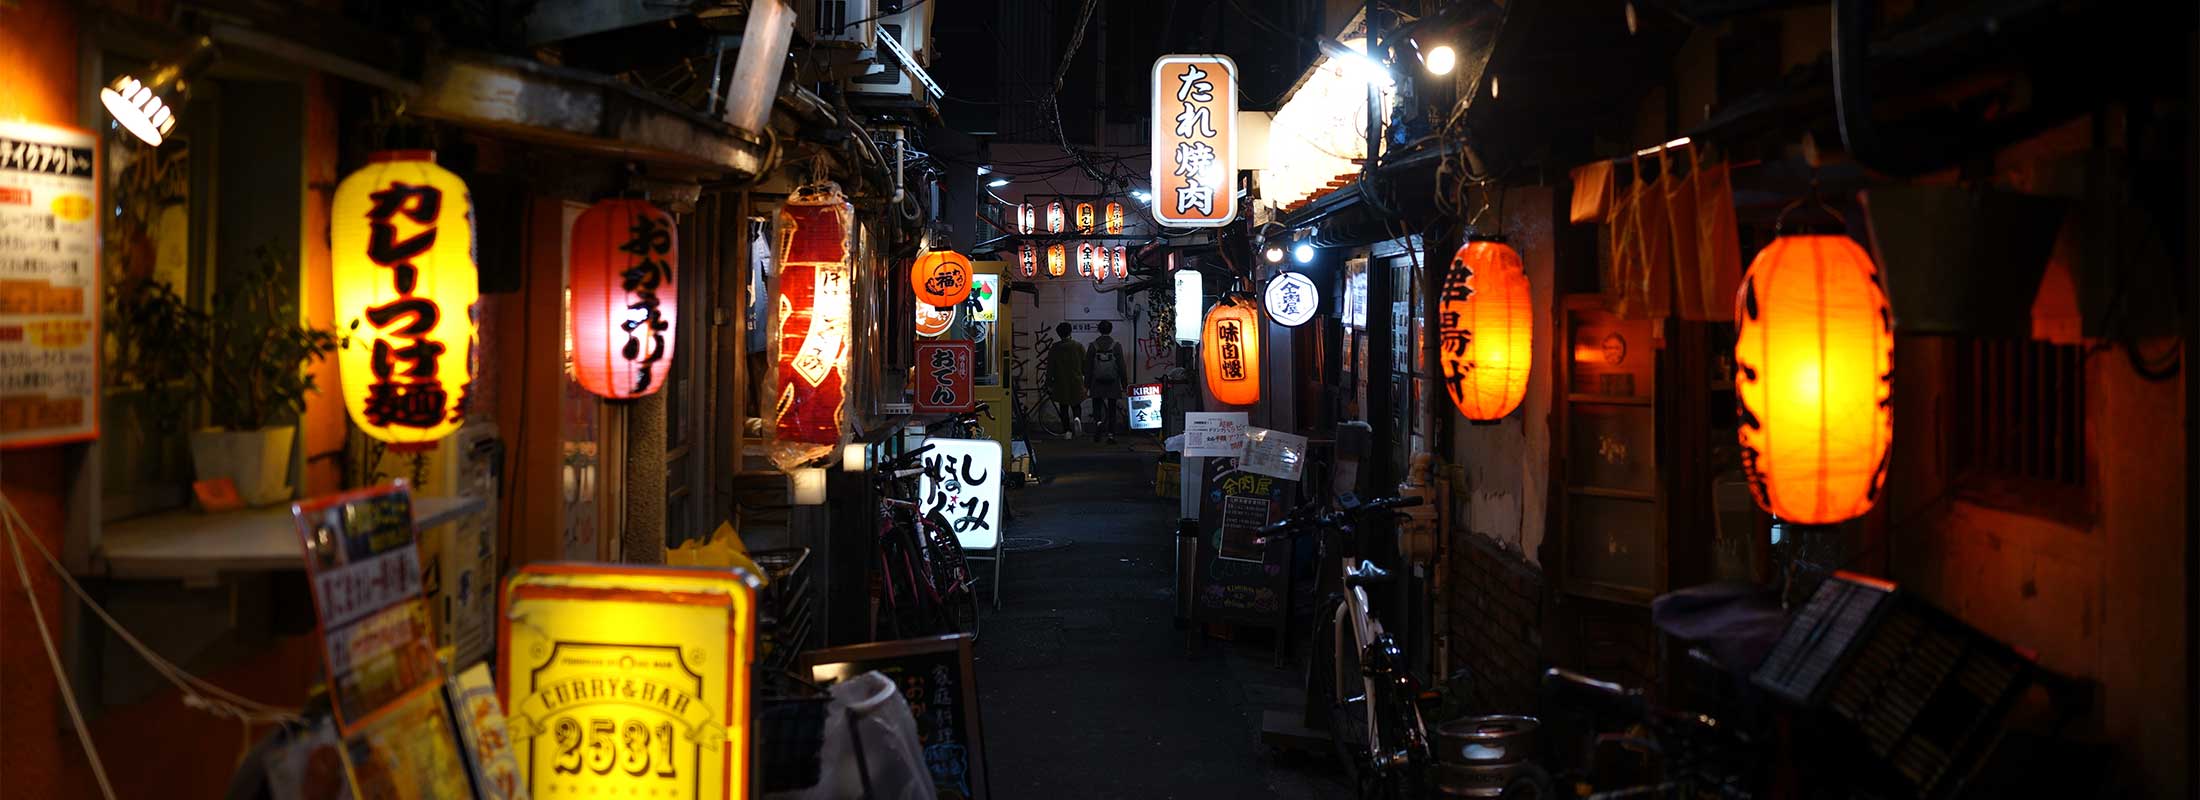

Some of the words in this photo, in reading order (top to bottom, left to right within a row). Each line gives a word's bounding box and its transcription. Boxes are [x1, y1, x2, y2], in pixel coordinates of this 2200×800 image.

[1174, 64, 1217, 216] たれ焼肉
[363, 181, 448, 428] カレーつけ麺
[930, 348, 956, 404] おでん
[1218, 321, 1242, 378] 味自慢
[1133, 386, 1160, 396] KIRIN
[553, 716, 677, 778] 2531
